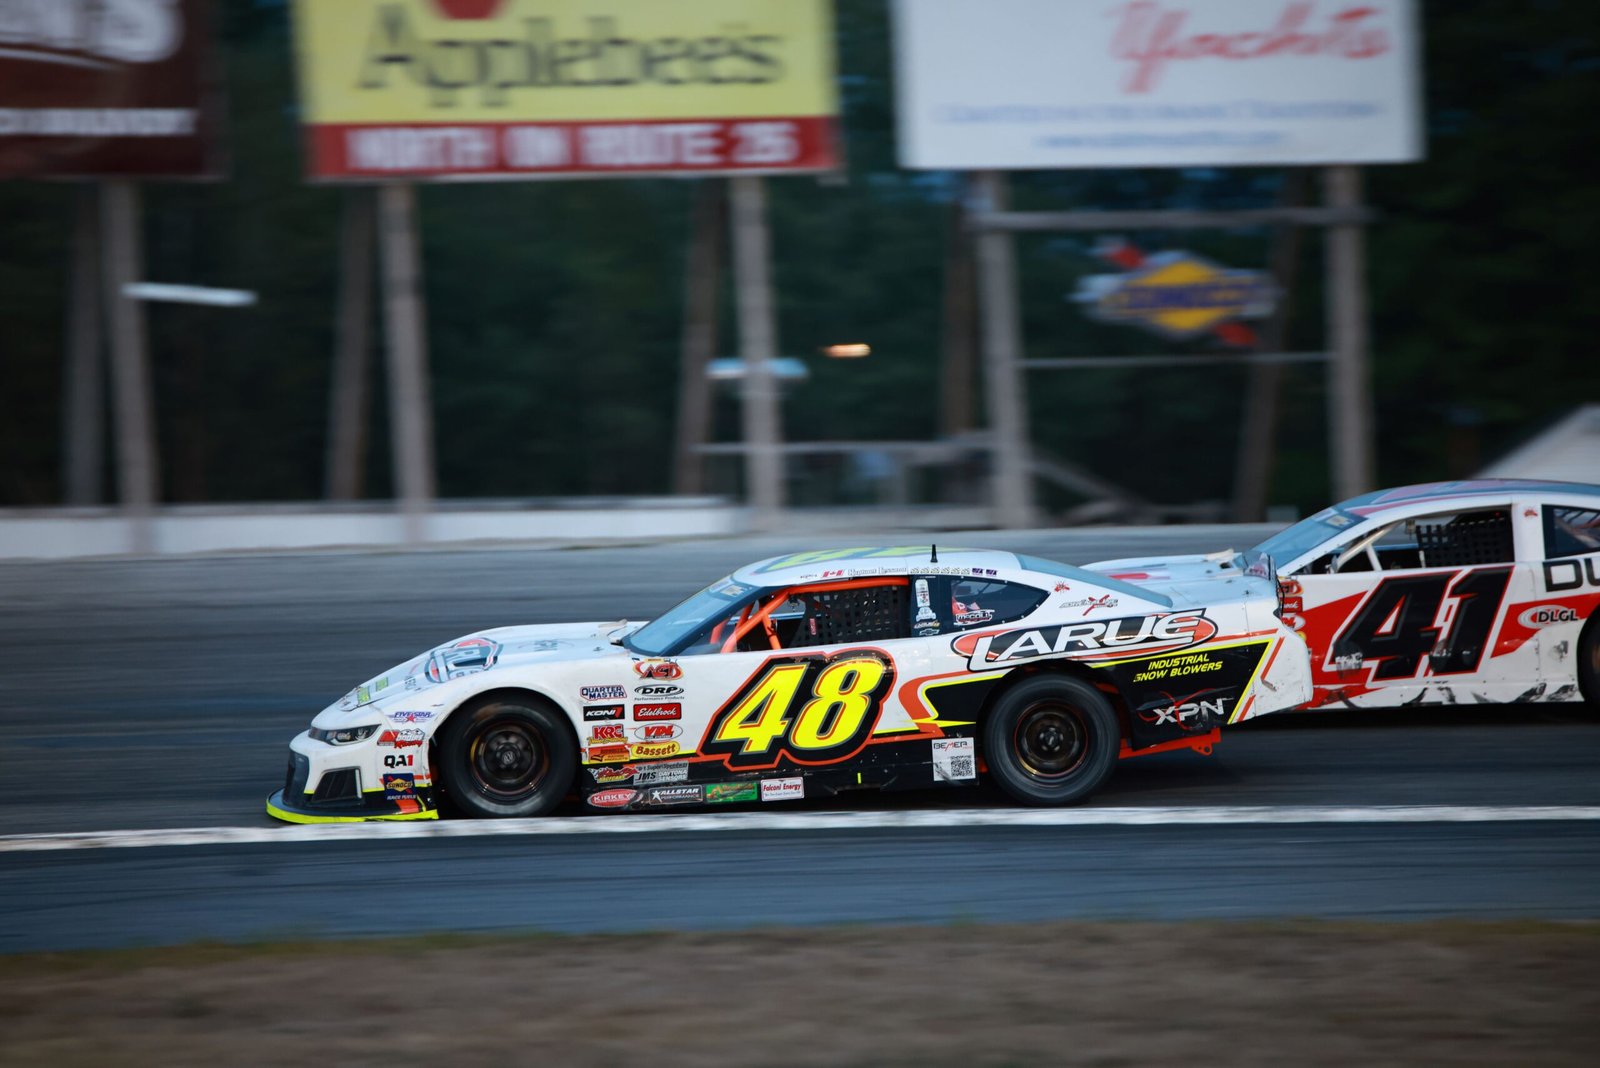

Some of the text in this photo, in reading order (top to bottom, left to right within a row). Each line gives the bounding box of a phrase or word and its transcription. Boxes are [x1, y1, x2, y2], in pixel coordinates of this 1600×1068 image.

[345, 126, 495, 168] NORTH
[503, 123, 572, 165] ON
[578, 120, 725, 164] ROUTE
[1537, 609, 1579, 623] DLGL
[1331, 567, 1514, 681] 41
[968, 608, 1207, 671] LARUE
[1148, 653, 1210, 671] INDUSTRIAL
[1133, 660, 1223, 682] SNOW BLOWERS
[581, 685, 622, 696] QUARTER
[588, 690, 625, 700] MASTER
[641, 685, 678, 695] DRP
[711, 656, 886, 755] 48
[586, 709, 616, 717] KONI
[637, 708, 677, 717] Edelbrock
[593, 723, 624, 740] KRC
[635, 743, 677, 756] Bassett
[933, 741, 968, 751] BEMER
[383, 754, 414, 769] QA1
[783, 783, 801, 791] Energy
[593, 793, 631, 802] KIRKEY
